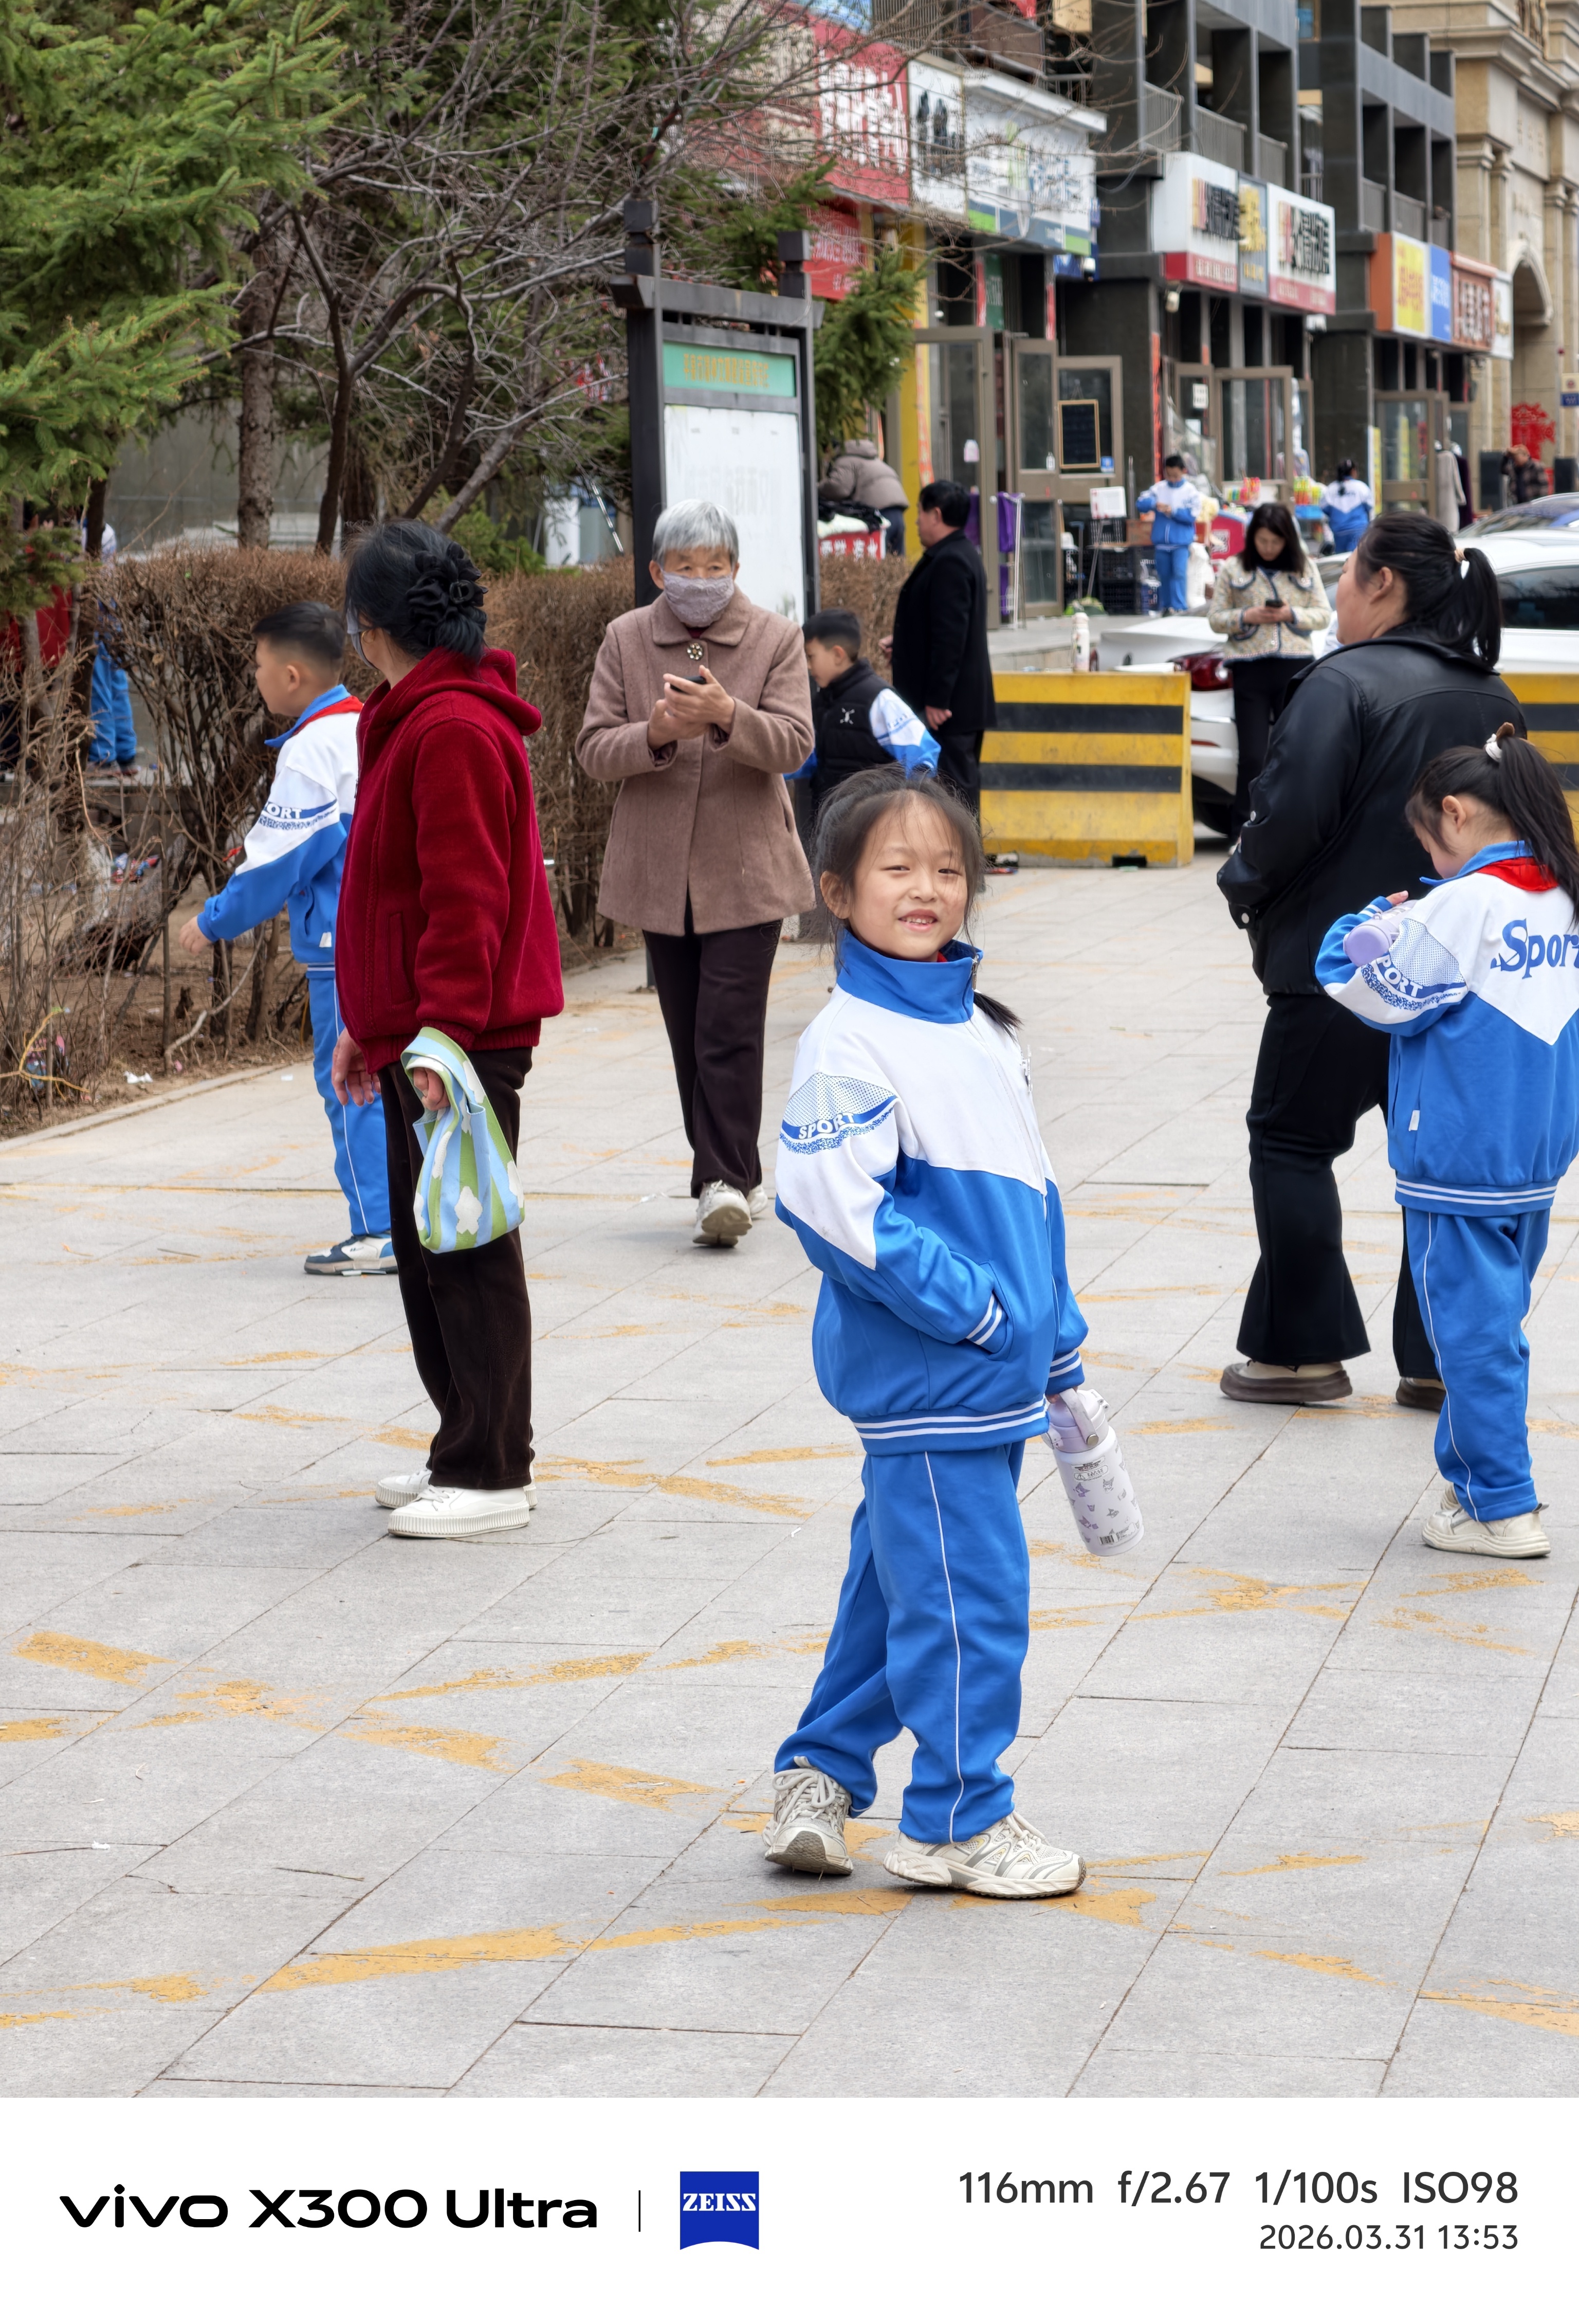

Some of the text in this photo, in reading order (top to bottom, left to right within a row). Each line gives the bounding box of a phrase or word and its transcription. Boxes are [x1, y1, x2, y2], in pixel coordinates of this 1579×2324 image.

[265, 802, 302, 820] ORT
[1377, 953, 1423, 998] PORT
[798, 1112, 856, 1140] SPORT
